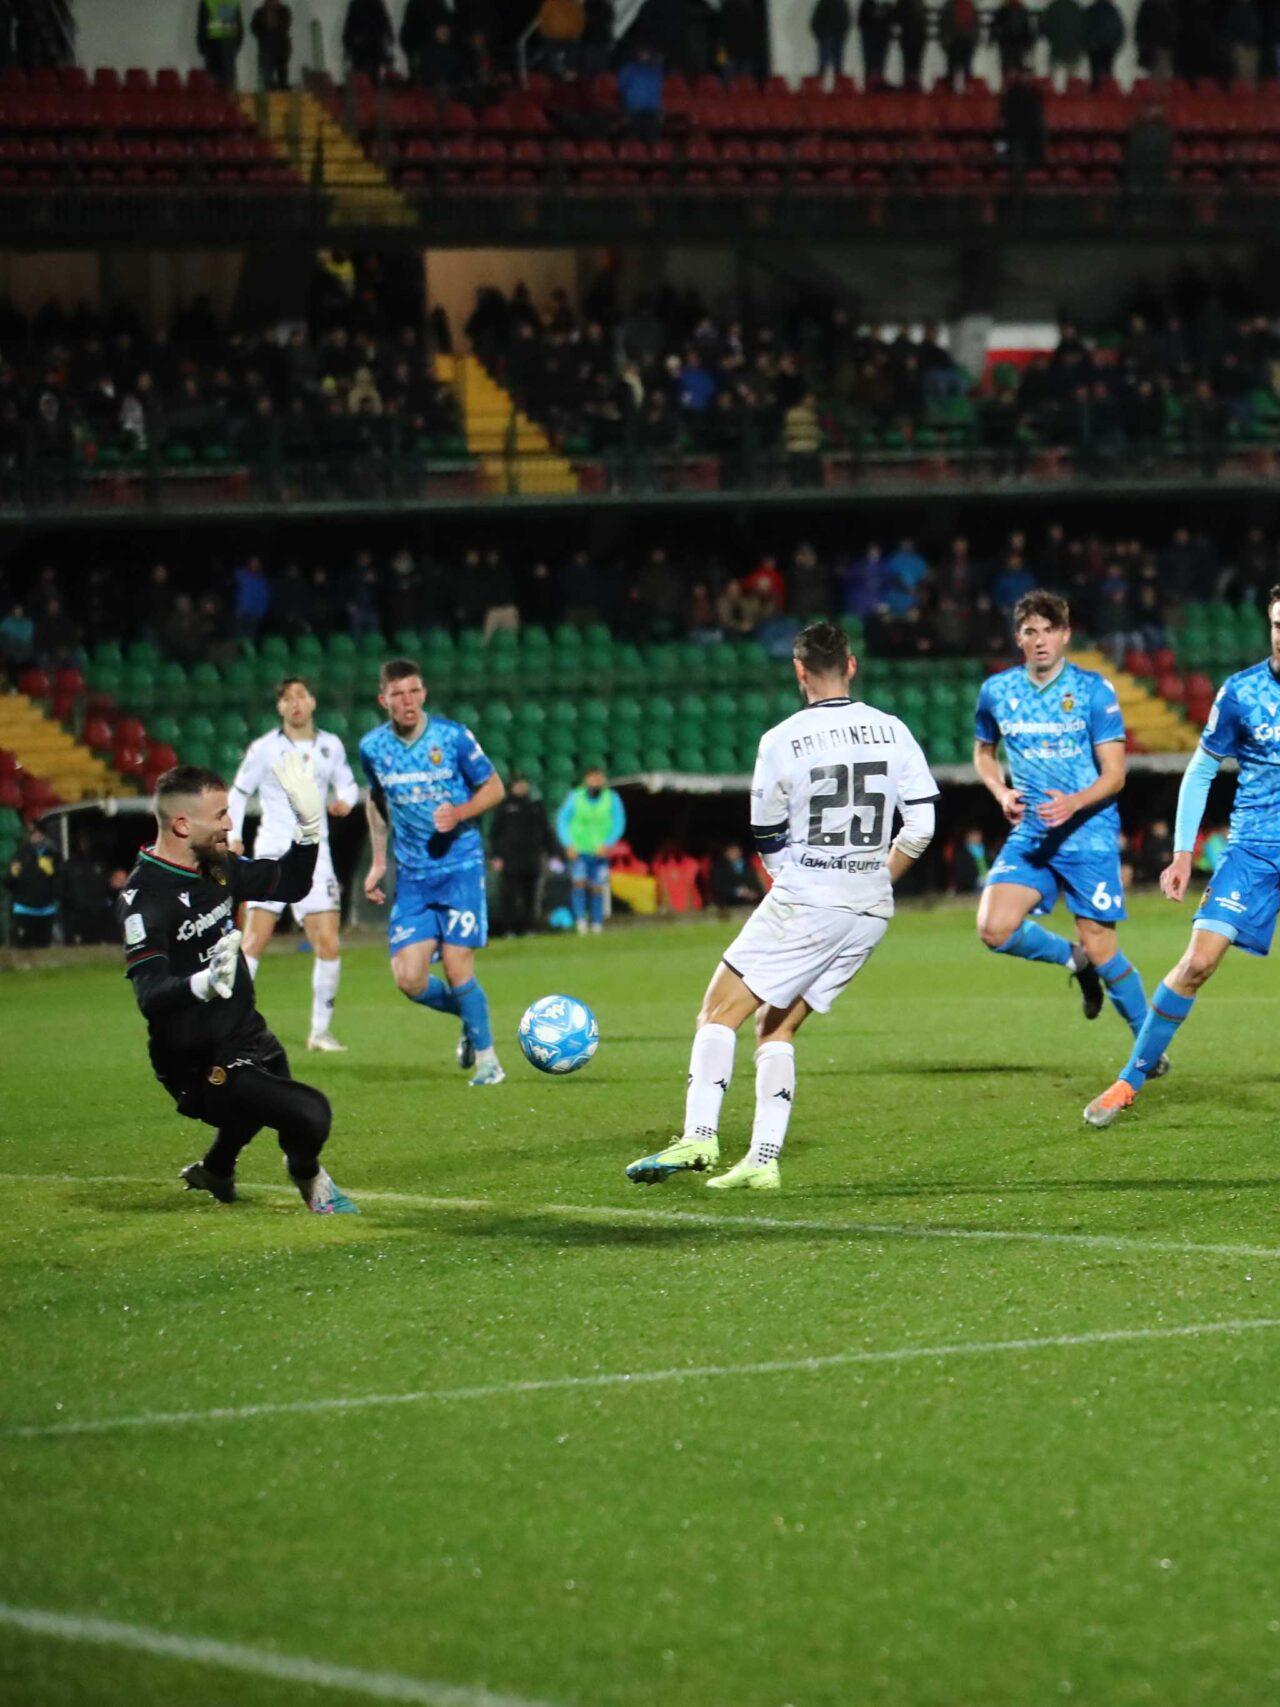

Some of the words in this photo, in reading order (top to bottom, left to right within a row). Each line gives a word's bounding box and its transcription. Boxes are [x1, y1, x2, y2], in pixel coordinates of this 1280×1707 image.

[808, 761, 888, 846] 25
[1092, 881, 1112, 911] 6
[446, 908, 476, 938] 79
